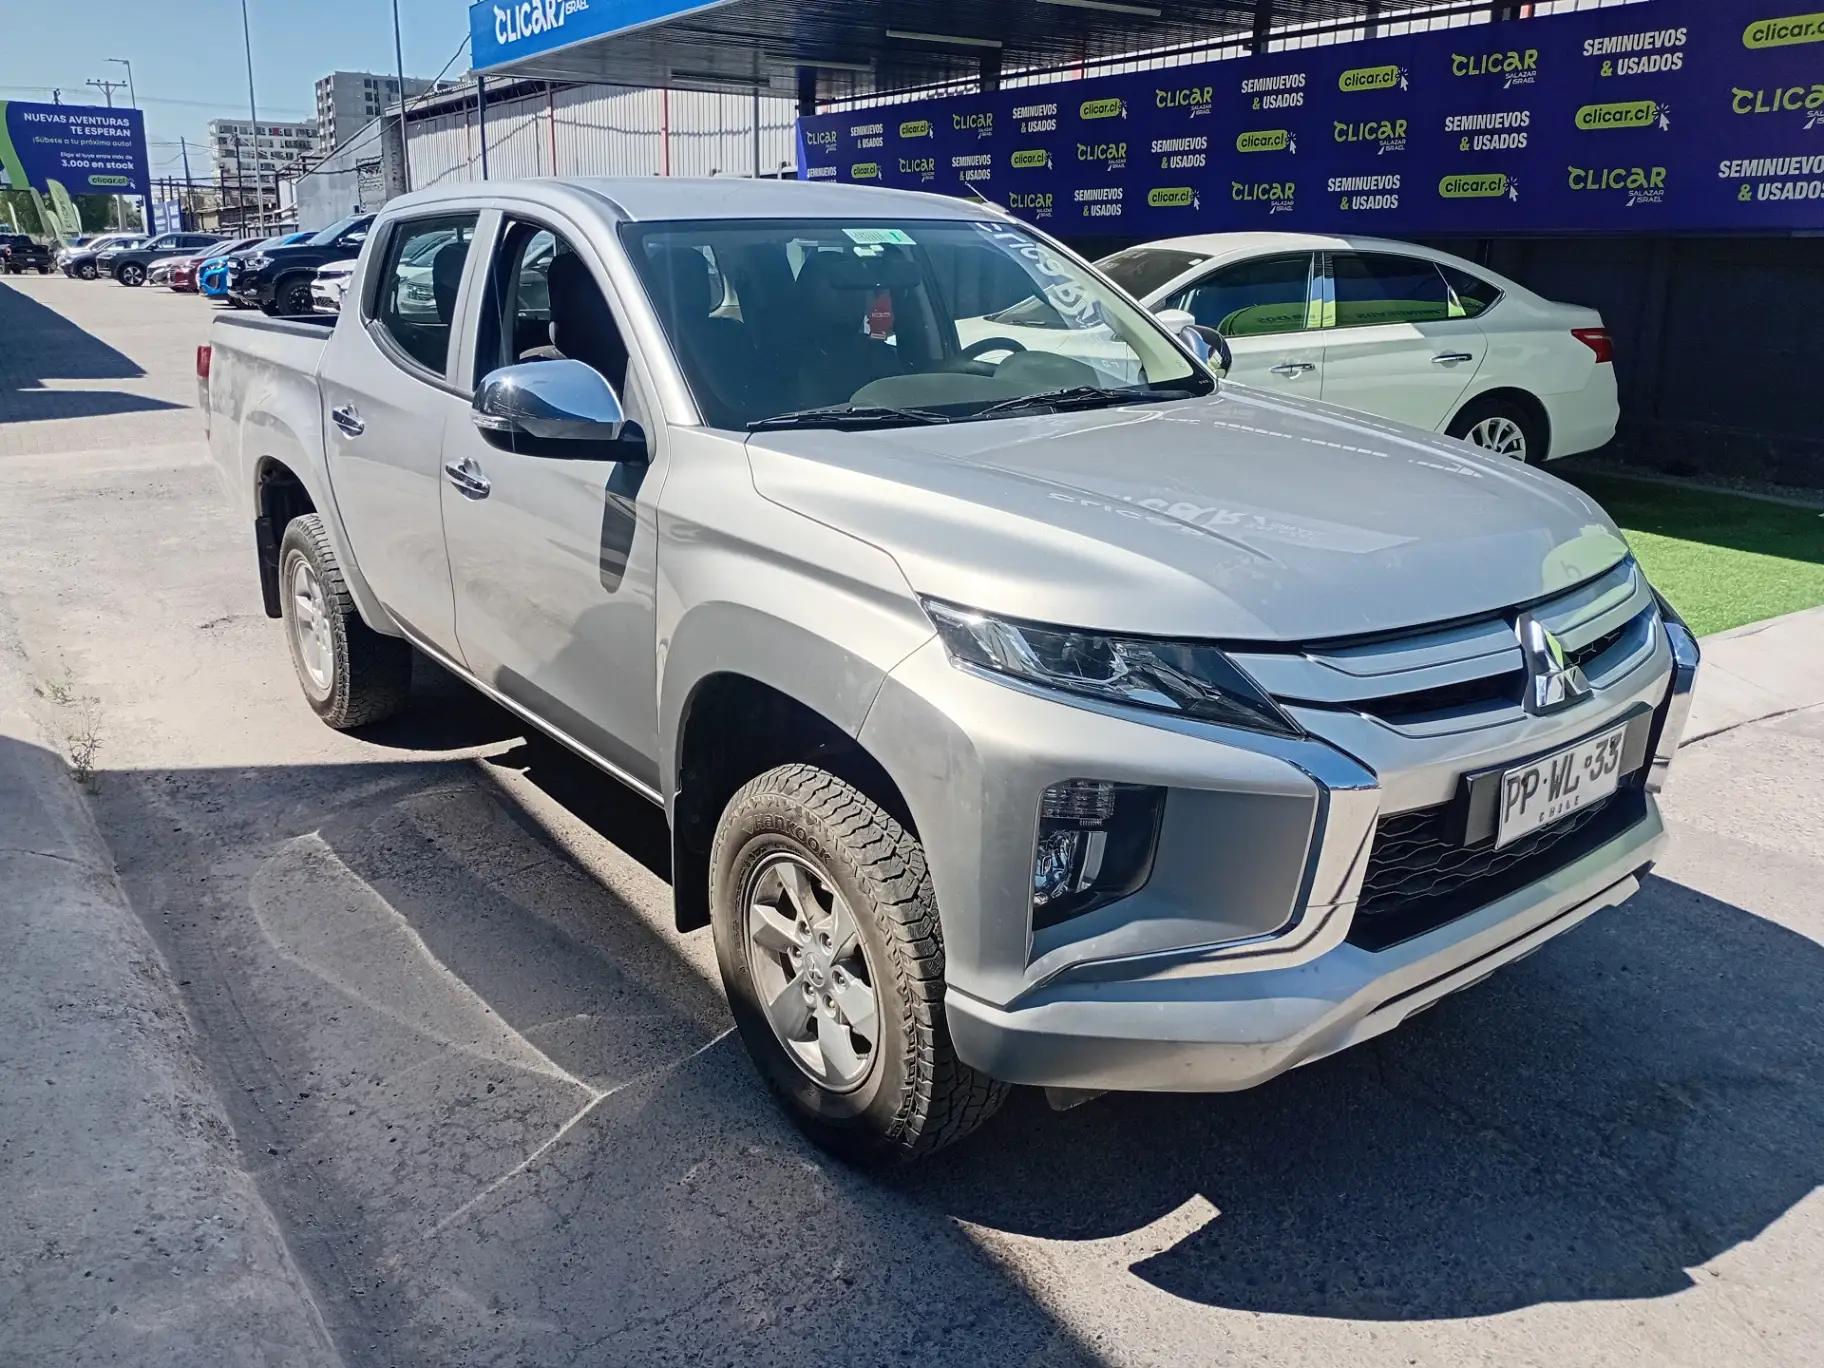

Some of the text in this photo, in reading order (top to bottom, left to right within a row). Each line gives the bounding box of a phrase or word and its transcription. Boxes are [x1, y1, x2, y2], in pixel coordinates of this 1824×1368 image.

[1583, 28, 1687, 56] SEMINUEVOS
[1600, 52, 1683, 76] & USADOS
[1345, 70, 1394, 86] clicar.cl
[1505, 71, 1536, 79] SALAZAR
[1241, 73, 1305, 93] SEMINUEVOS
[1253, 92, 1303, 109] & USADOS
[1012, 104, 1057, 119] SEMINUEVOS
[1084, 102, 1117, 115] clicar.cl
[1583, 106, 1650, 124] clicar.cl
[24, 113, 130, 127] NUEVAS AVENTURAS
[1021, 119, 1056, 133] & USADOS
[1445, 111, 1529, 132] SEMINUEVOS
[70, 126, 131, 137] TE ESPERAN
[851, 124, 883, 136] SEMINUEVOS
[901, 124, 926, 134] clicar.cl
[863, 137, 883, 148] USADOS
[1151, 137, 1207, 153] SEMINUEVOS
[1241, 134, 1284, 148] clicar.cl
[1460, 133, 1527, 151] & USADOS
[61, 159, 90, 168] 3.000
[106, 161, 134, 170] stock
[952, 155, 991, 167] SEMINUEVOS
[1014, 154, 1044, 164] clicar.cl
[1161, 154, 1206, 168] & USADOS
[854, 165, 876, 175] clicar.cl
[960, 169, 990, 180] & USADOS
[92, 176, 126, 185] clicar.cl
[1328, 175, 1400, 192] SEMINUEVOS
[1446, 179, 1501, 192] clicar.cl
[1074, 188, 1123, 201] SEMINUEVOS
[1152, 190, 1189, 203] clicar.cl
[1738, 184, 1751, 201] &
[1340, 195, 1398, 210] & USADOS
[1083, 204, 1121, 216] & USADOS
[1538, 796, 1580, 823] CHILE
